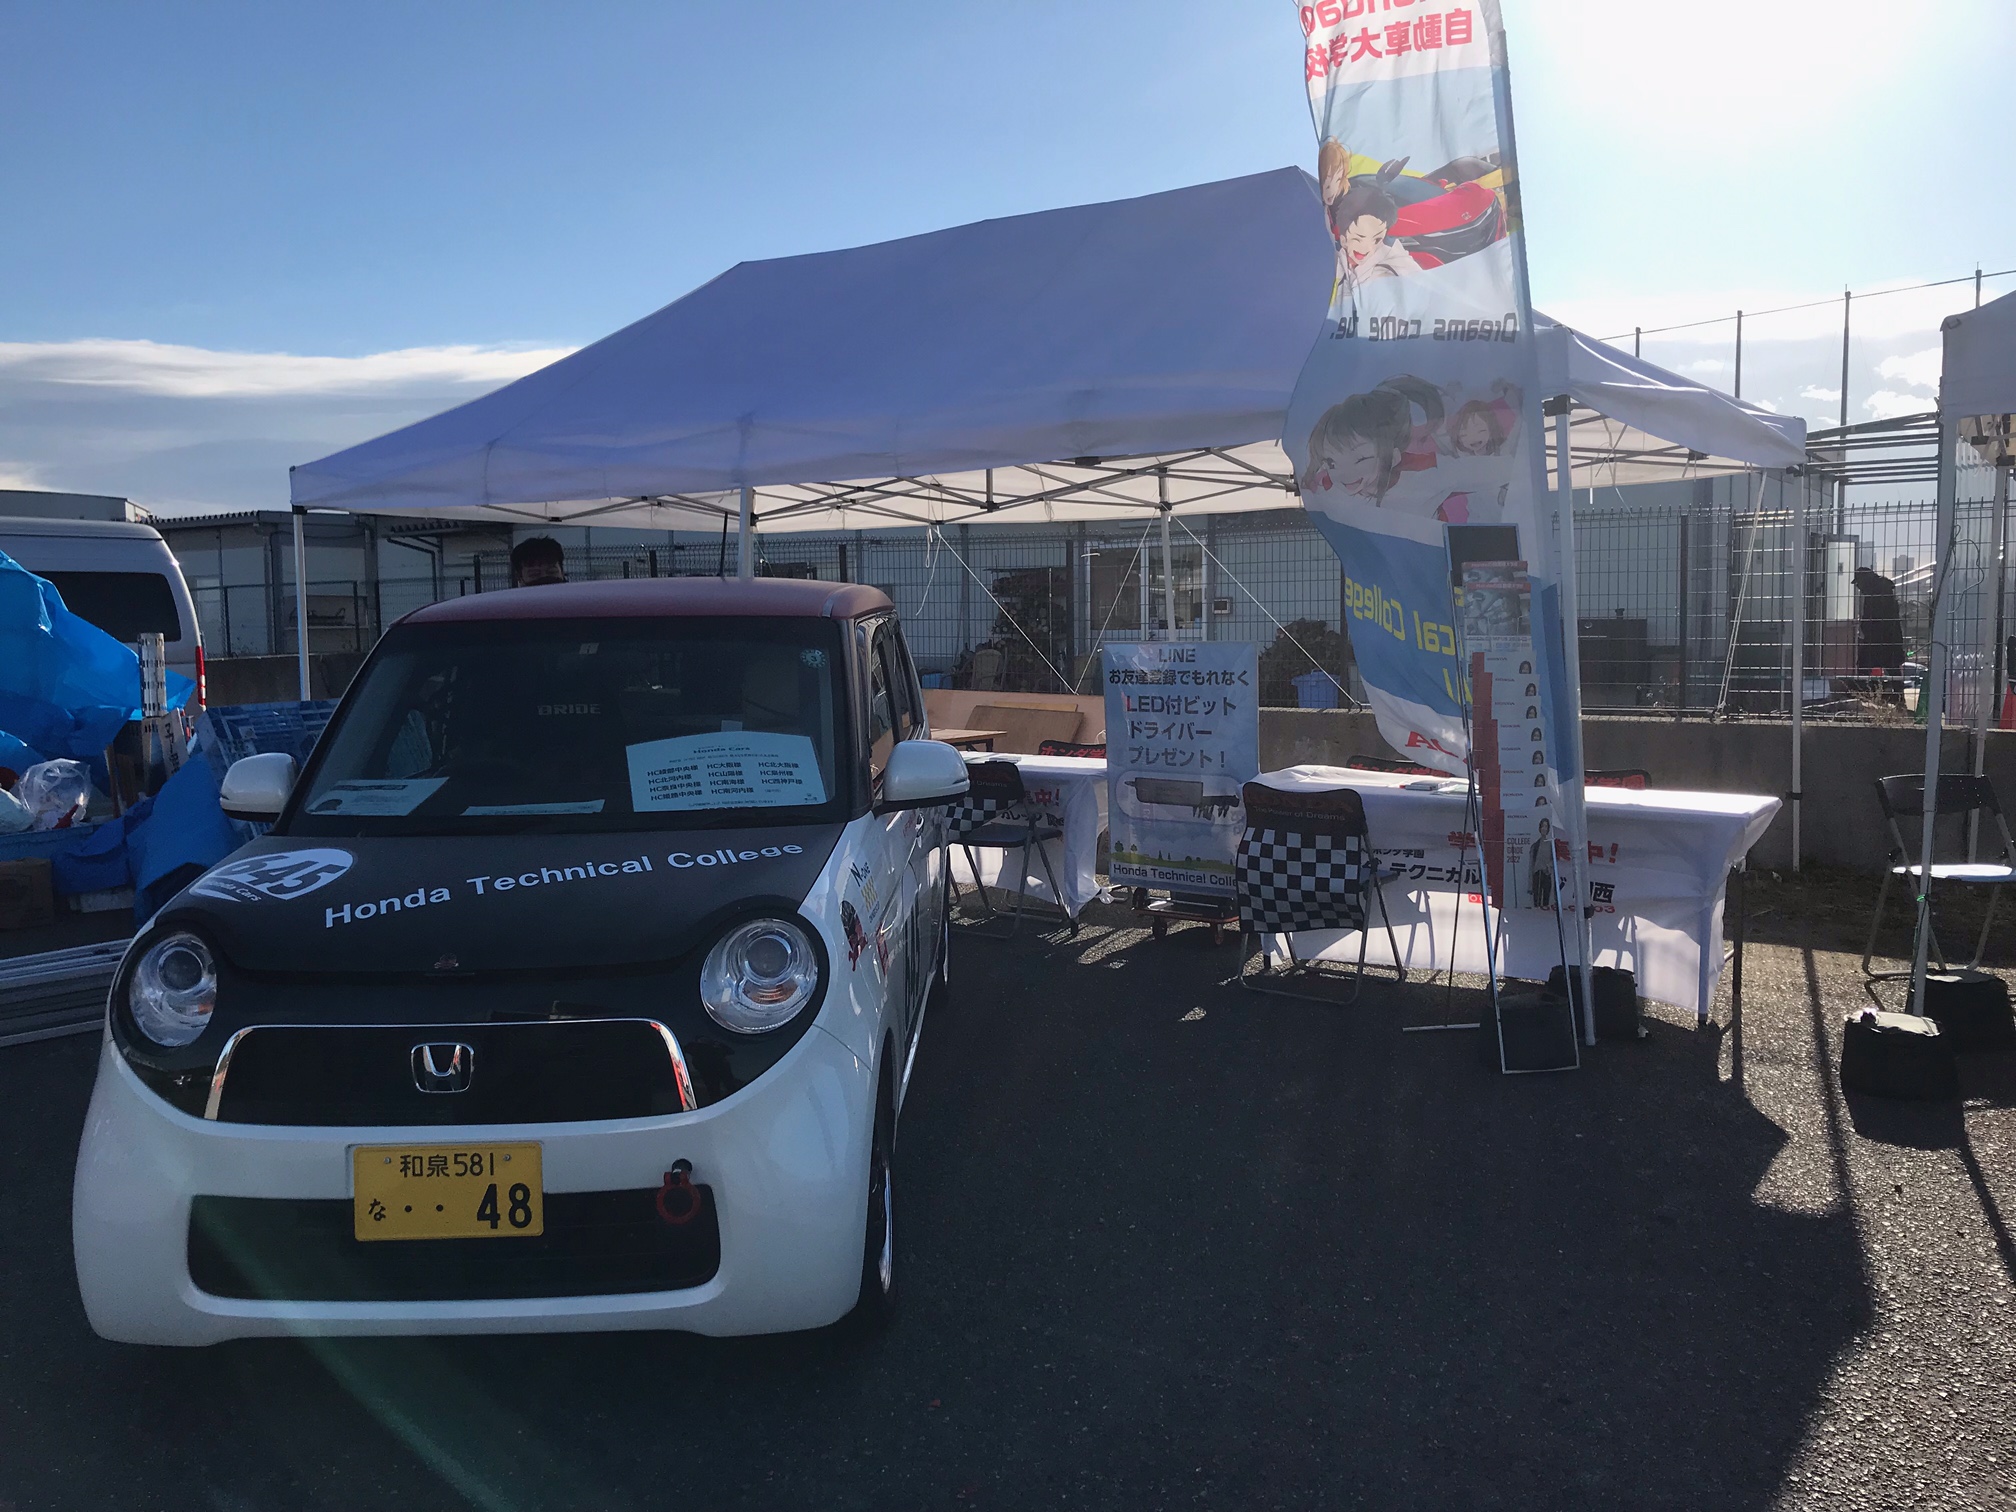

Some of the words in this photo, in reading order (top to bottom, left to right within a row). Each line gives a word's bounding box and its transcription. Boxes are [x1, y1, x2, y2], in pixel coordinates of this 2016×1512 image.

[1158, 648, 1196, 663] LINE
[1108, 669, 1249, 688] お友達登録でもれなく
[537, 703, 601, 716] BRIDE
[1126, 695, 1237, 716] LED付ビット
[1128, 721, 1213, 740] ドライバー
[1306, 811, 1346, 821] Dreams
[1506, 837, 1531, 845] COLLEGE
[1113, 863, 1148, 878] Honda
[1150, 867, 1207, 884] Technical
[324, 886, 451, 929] Honda
[467, 855, 653, 896] Technical
[667, 841, 804, 870] College
[368, 1198, 387, 1222] な
[476, 1182, 533, 1229] 48
